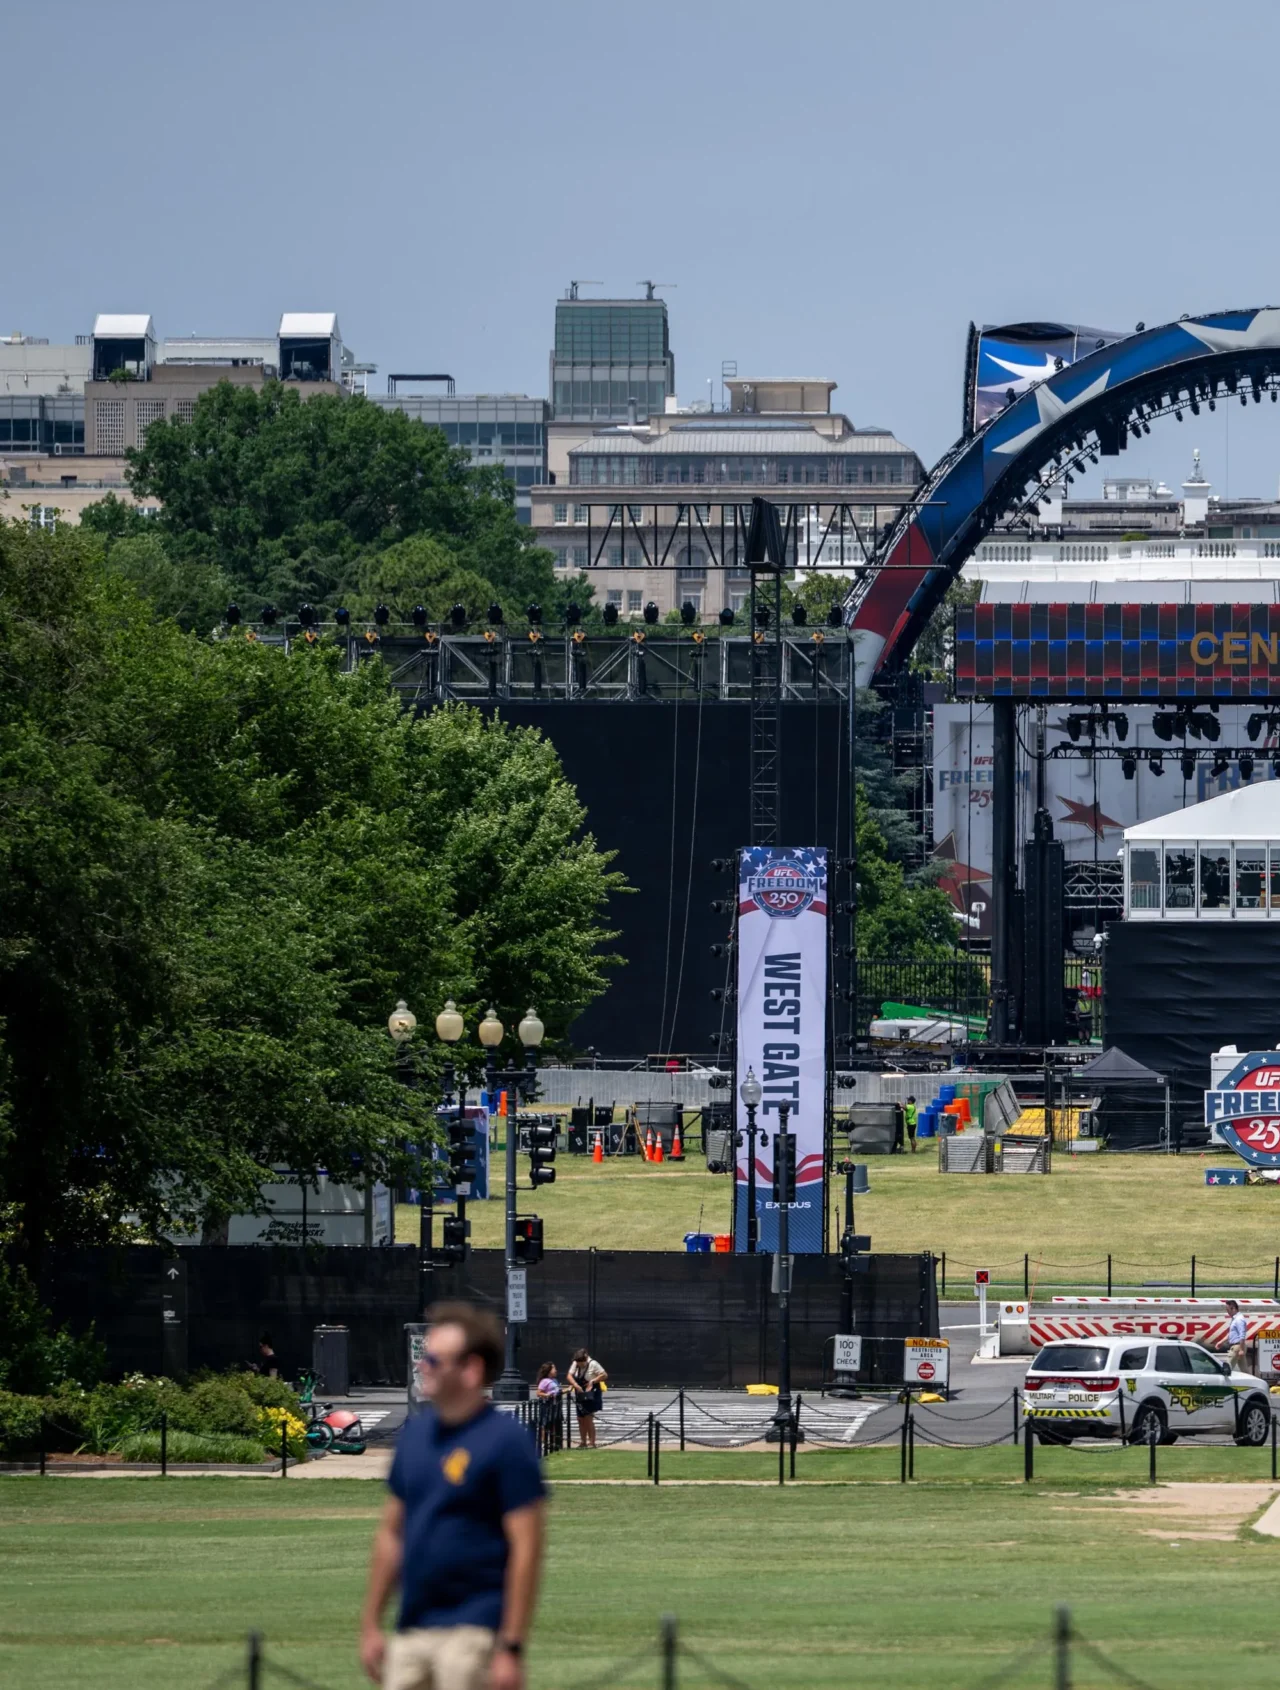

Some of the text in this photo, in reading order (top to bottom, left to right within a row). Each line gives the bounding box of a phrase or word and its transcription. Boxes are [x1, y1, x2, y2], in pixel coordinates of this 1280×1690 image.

[970, 789, 993, 808] 25
[773, 869, 793, 877] UFC
[748, 877, 819, 893] FREEDOM
[769, 892, 799, 908] 250
[762, 952, 801, 1116] WEST GATE
[765, 1201, 811, 1209] EXDUS
[1112, 1321, 1212, 1335] STOP
[912, 1339, 941, 1347] NOTICE
[1068, 1394, 1099, 1402] POLICE
[1170, 1396, 1224, 1408] POLICE
